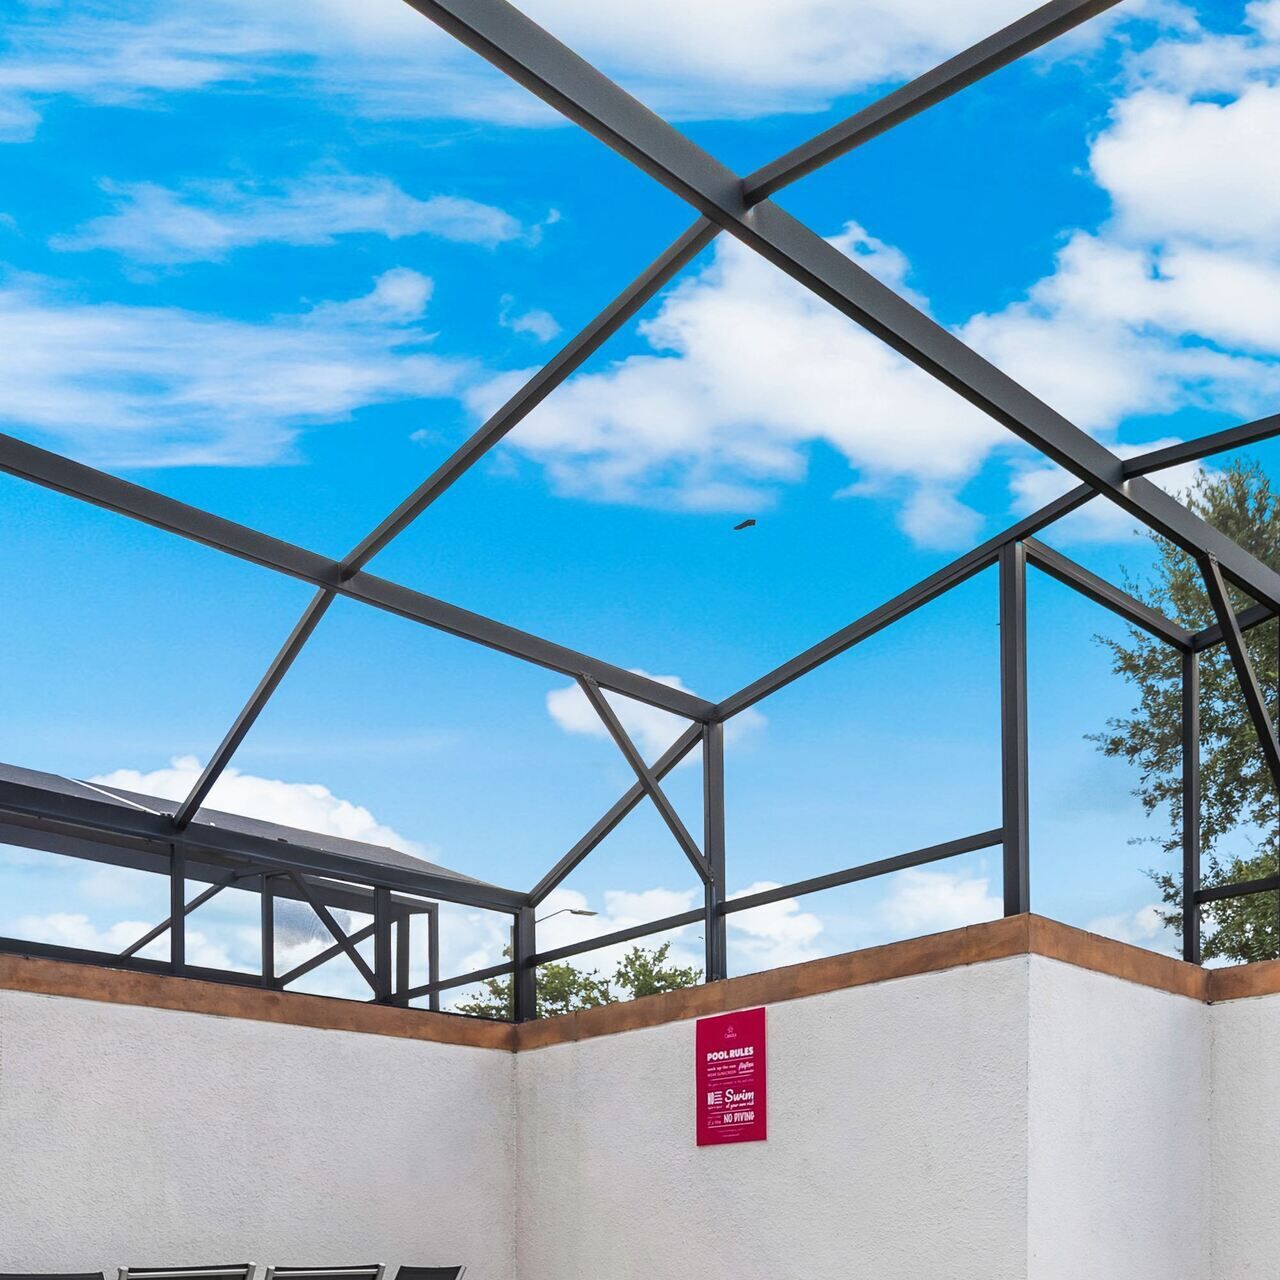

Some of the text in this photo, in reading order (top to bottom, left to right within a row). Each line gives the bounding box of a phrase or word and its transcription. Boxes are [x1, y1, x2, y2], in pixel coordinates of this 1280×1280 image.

[707, 1047, 754, 1061] POOL RULES
[725, 1089, 754, 1102] Swim
[723, 1113, 733, 1123] NO
[733, 1111, 754, 1122] DIVING
